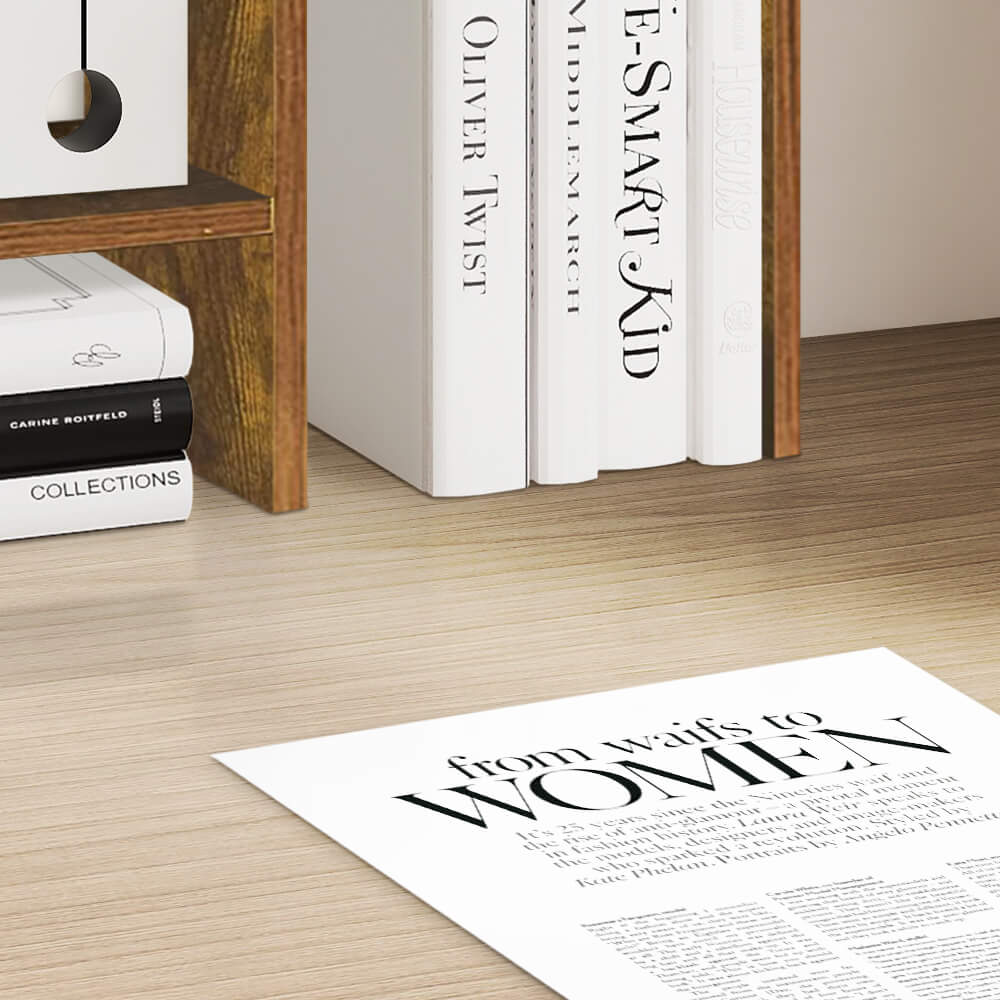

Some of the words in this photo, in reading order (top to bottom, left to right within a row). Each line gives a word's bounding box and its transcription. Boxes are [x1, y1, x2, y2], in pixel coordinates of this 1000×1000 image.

[463, 16, 499, 161] OLIVER
[463, 174, 498, 294] TWIST
[10, 418, 58, 429] CARINE
[64, 411, 127, 423] ROITFELD
[30, 470, 181, 501] COLLECTIONS
[392, 716, 951, 830] WOMEN
[447, 746, 594, 780] from
[601, 717, 753, 755] waifs
[761, 711, 824, 731] to
[515, 829, 555, 841] It's
[558, 822, 585, 835] 25
[589, 816, 648, 828] years
[650, 805, 705, 820] since
[709, 799, 747, 810] the
[847, 772, 893, 787] waif
[897, 766, 938, 780] and
[522, 840, 559, 851] the
[562, 834, 601, 845] rise
[600, 826, 627, 838] of
[872, 773, 959, 795] moment
[541, 850, 569, 859] in
[570, 837, 653, 855] fashion
[653, 823, 736, 841] history.
[867, 790, 939, 806] speaks
[941, 786, 966, 794] to
[552, 858, 589, 869] the
[595, 843, 682, 862] models,
[684, 826, 788, 847] designers
[790, 816, 832, 830] and
[575, 874, 625, 888] Kate
[630, 861, 717, 879] Phelan.
[713, 845, 809, 865] Portraits
[807, 839, 838, 849] by
[591, 861, 641, 873] who
[643, 843, 732, 866] sparked
[752, 824, 869, 847] revolution.
[940, 807, 970, 816] by
